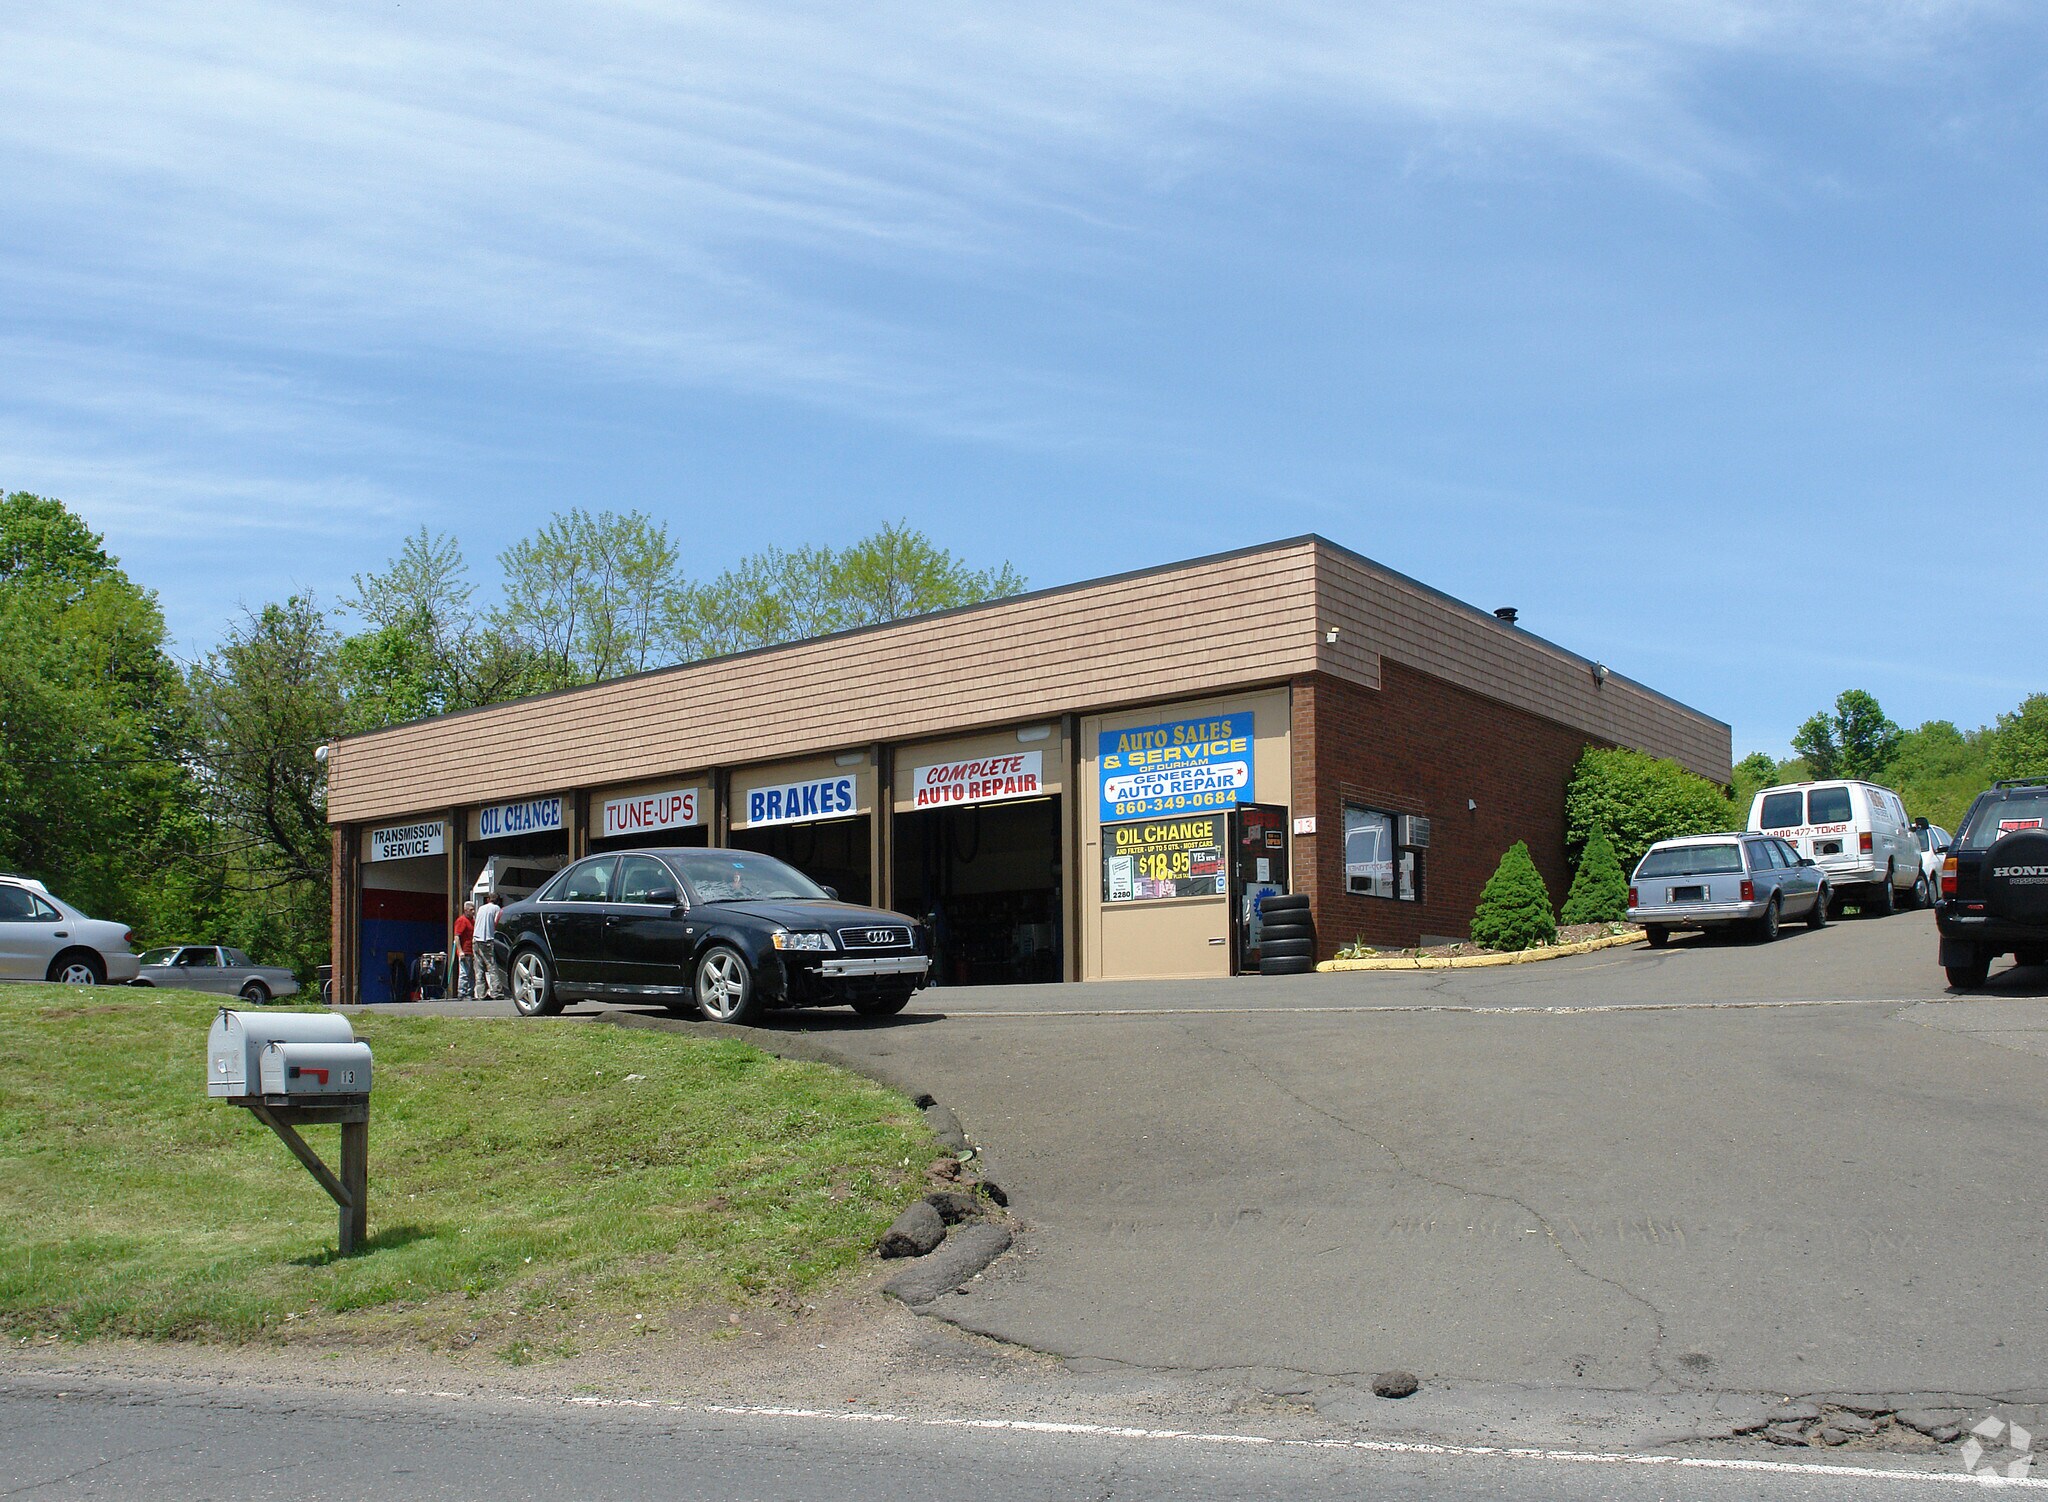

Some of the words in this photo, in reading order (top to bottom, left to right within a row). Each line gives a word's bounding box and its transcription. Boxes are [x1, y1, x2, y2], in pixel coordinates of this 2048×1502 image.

[1117, 729, 1167, 752] AUTO
[1173, 720, 1232, 744] SALES
[1104, 755, 1121, 769] &
[1128, 738, 1247, 766] SERVICE
[1139, 765, 1155, 773] OF
[1156, 758, 1209, 771] DURHAM
[926, 755, 1025, 785] COMPLETE
[1134, 767, 1216, 784] GENERAL
[917, 783, 964, 806] AUTO
[969, 773, 1037, 799] REPAIR
[1117, 783, 1164, 800] AUTO
[1170, 775, 1234, 793] REPAIR
[606, 794, 694, 831] TUNE-UPS
[751, 780, 851, 823] BRAKES
[1115, 790, 1237, 815] 860-349-0684
[481, 808, 501, 836] OIL
[504, 799, 560, 832] CHANGE
[1297, 819, 1313, 833] 13
[374, 823, 442, 844] TRANSMISSION
[1116, 827, 1142, 845] OIL
[1144, 821, 1213, 843] CHANGE
[383, 839, 429, 858] SERVICE
[1193, 852, 1205, 862] YES
[1139, 852, 1189, 880] $18.95
[1993, 866, 2048, 877] HOND
[2009, 877, 2048, 885] PASSPOR
[343, 1071, 354, 1084] 13
